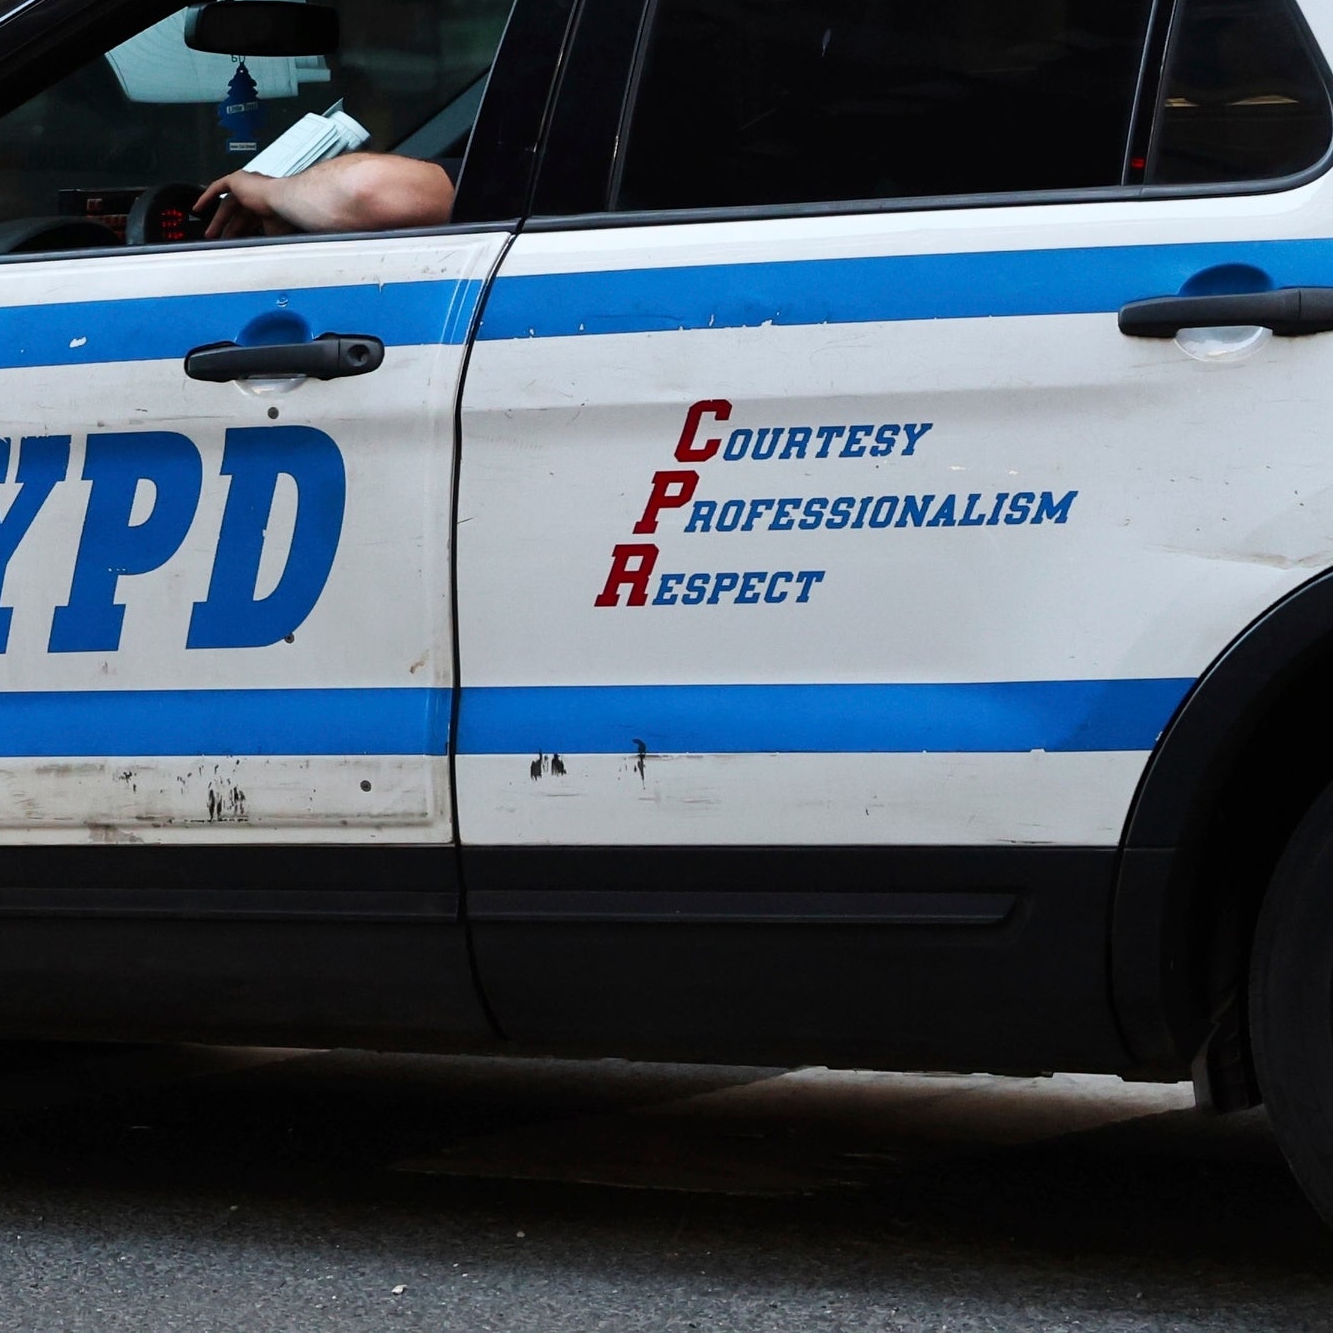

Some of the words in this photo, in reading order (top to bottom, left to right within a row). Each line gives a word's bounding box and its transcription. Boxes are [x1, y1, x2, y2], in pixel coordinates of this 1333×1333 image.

[673, 398, 934, 463] COURTESY
[632, 469, 1079, 535] PROFESSIONALISM
[593, 542, 827, 607] RESPECT
